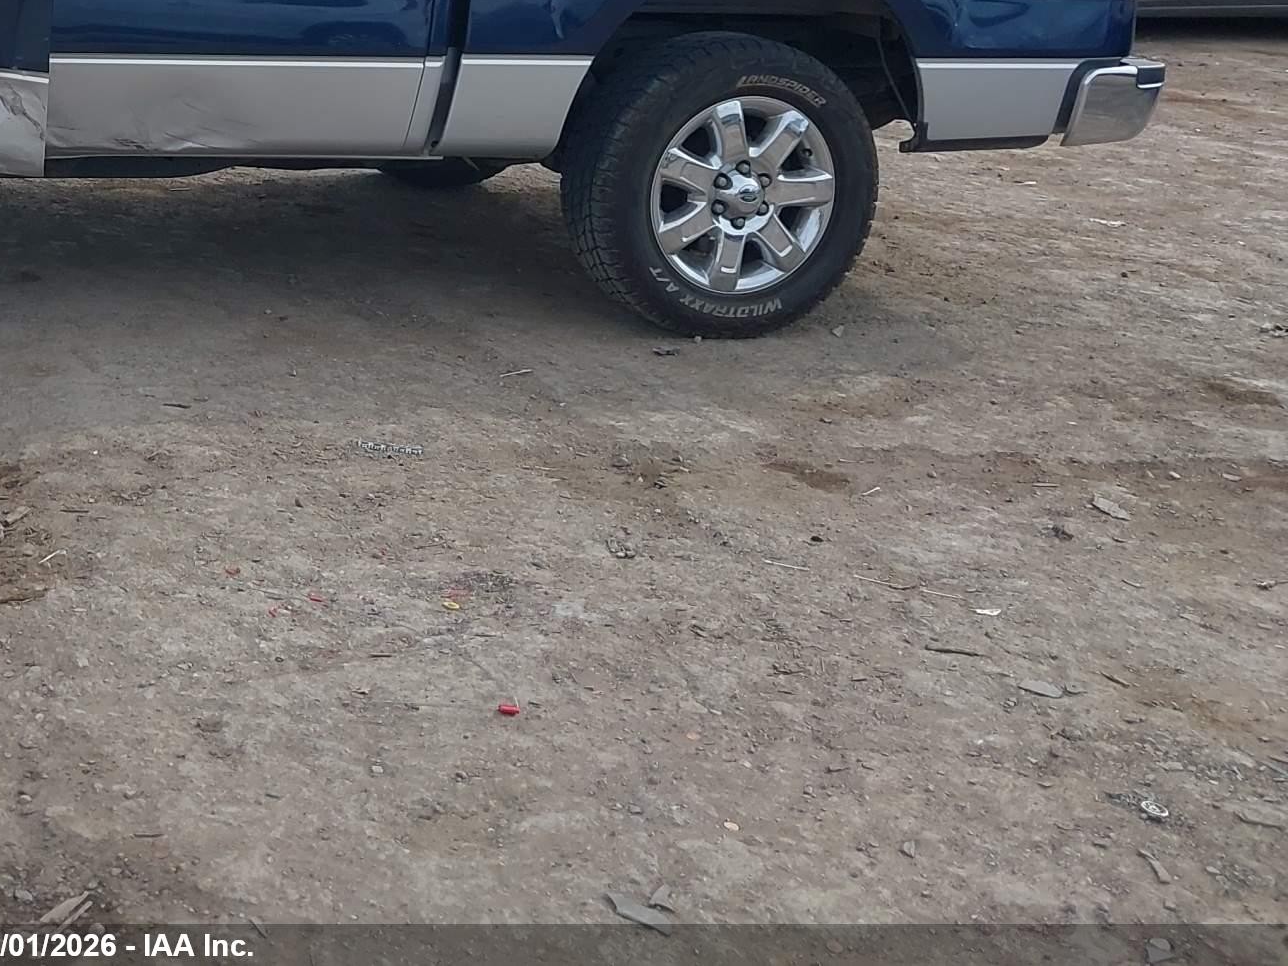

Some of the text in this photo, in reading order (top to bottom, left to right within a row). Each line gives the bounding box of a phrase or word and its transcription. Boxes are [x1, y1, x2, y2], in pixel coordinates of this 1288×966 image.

[736, 75, 827, 108] LANDSPIDER
[648, 266, 783, 318] WILDTRAXX A/T
